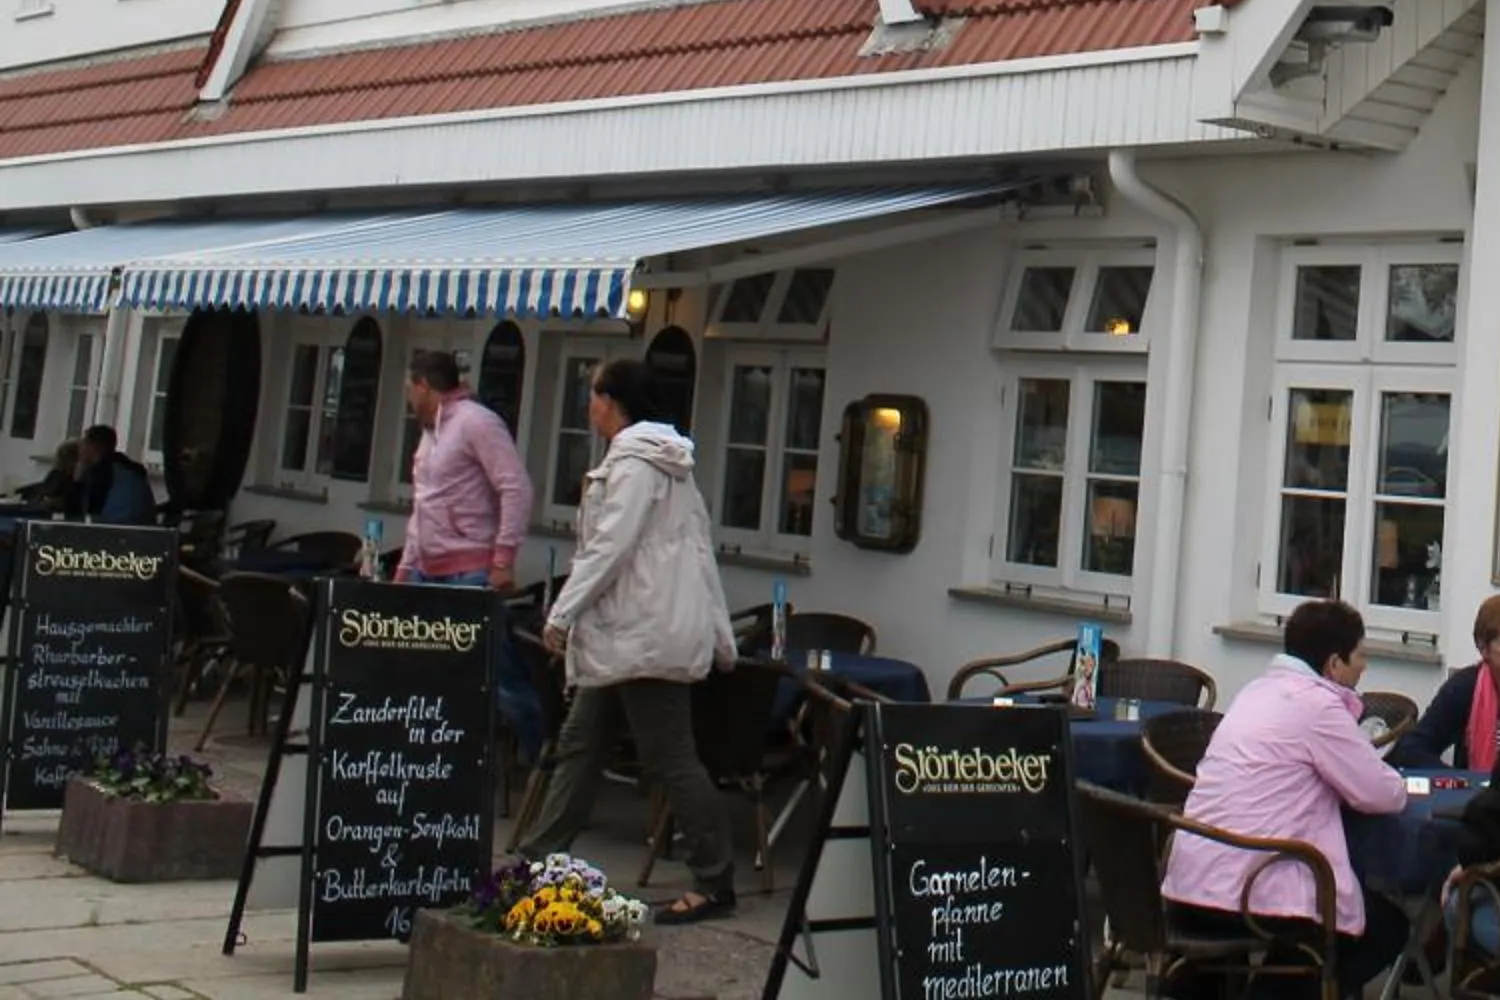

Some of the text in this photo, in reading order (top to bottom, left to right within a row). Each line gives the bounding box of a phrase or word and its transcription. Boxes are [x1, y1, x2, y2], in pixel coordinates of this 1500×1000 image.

[35, 545, 164, 580] Störtebeker
[339, 609, 481, 651] Störtebeker
[330, 691, 444, 728] Zanderfilet
[409, 720, 465, 744] in der
[895, 743, 1051, 793] Störtebeker
[376, 781, 410, 815] auf
[321, 865, 471, 902] Butterkartoffeln
[931, 896, 1004, 935] pfanne
[927, 927, 964, 964] mit
[921, 962, 1069, 1000] mediterranen
